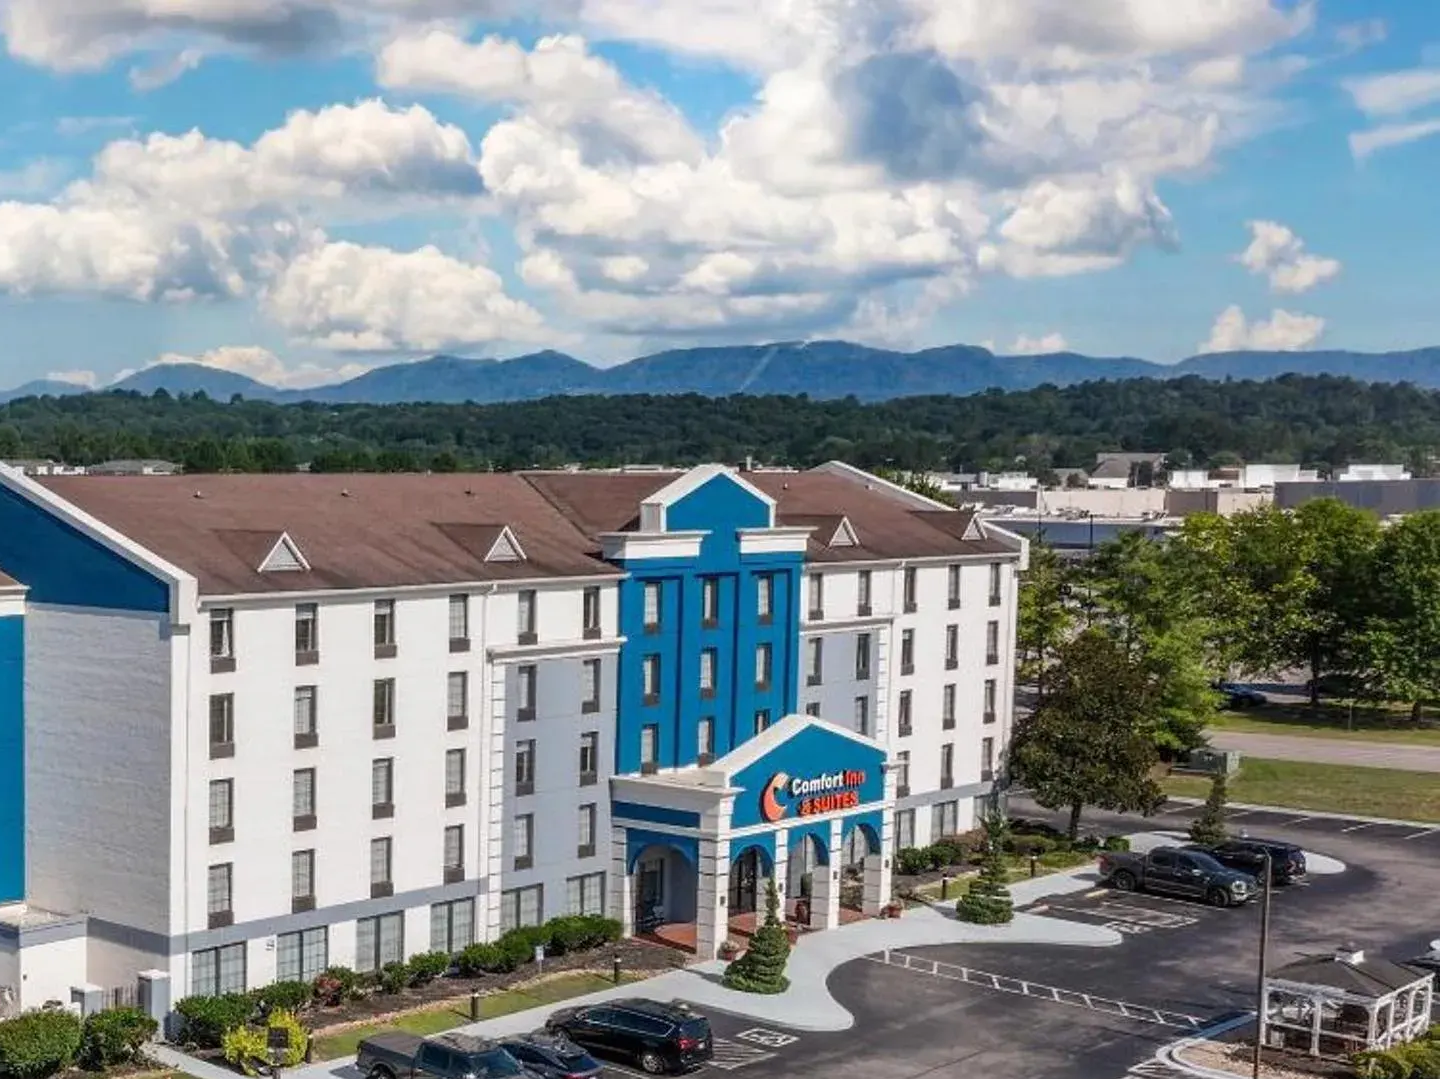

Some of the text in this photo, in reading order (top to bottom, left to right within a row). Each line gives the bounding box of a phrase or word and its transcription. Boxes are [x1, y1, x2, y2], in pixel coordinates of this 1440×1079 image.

[792, 770, 864, 794] Comfort Inn
[814, 791, 858, 813] SUITES
